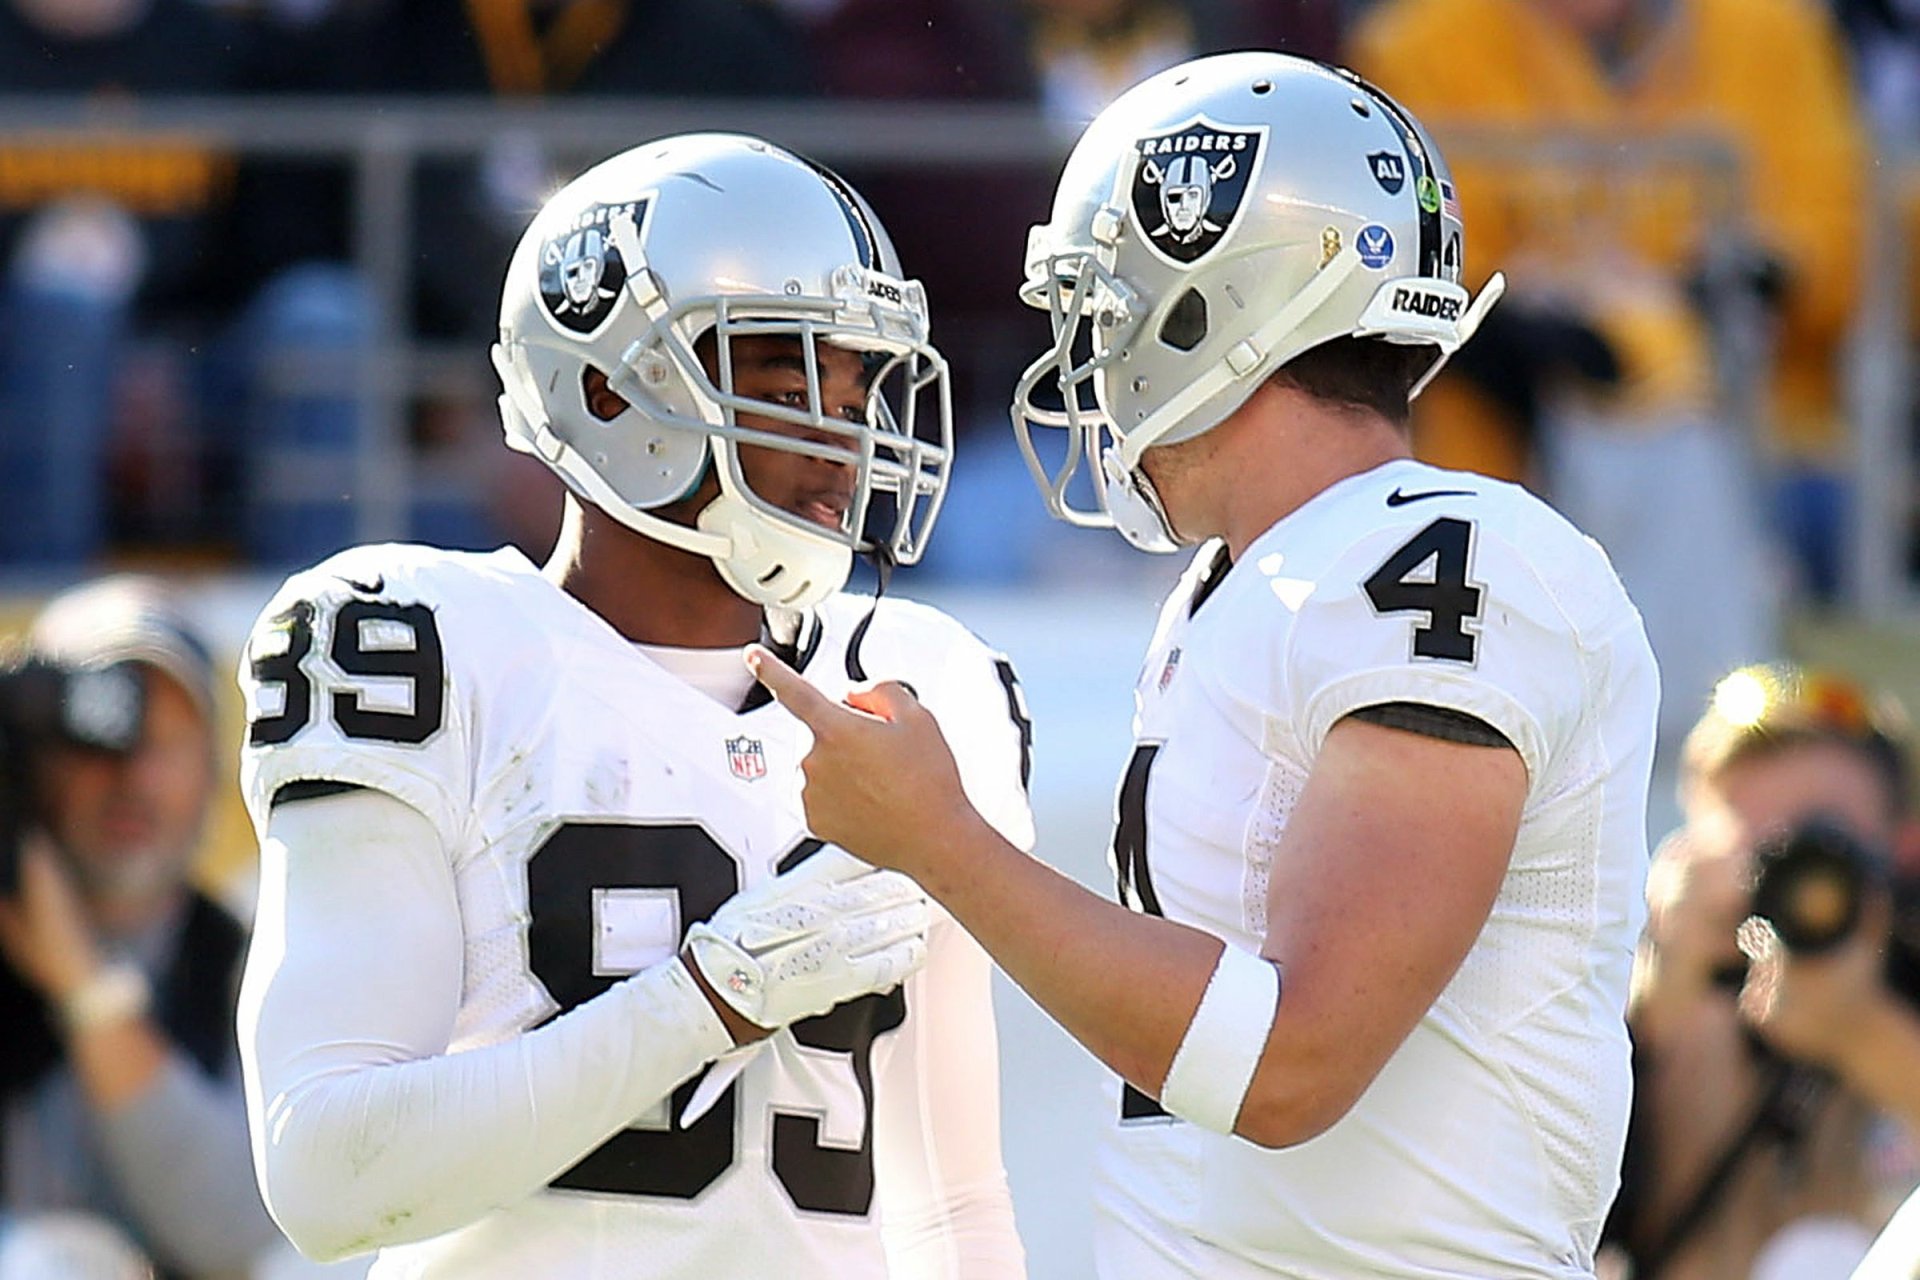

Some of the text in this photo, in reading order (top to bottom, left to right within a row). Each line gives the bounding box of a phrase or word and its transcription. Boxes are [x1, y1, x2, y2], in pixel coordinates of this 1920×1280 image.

[1143, 134, 1247, 156] RAIDERS
[1377, 160, 1402, 179] AL
[1364, 517, 1481, 662] 4
[731, 753, 764, 776] NFL
